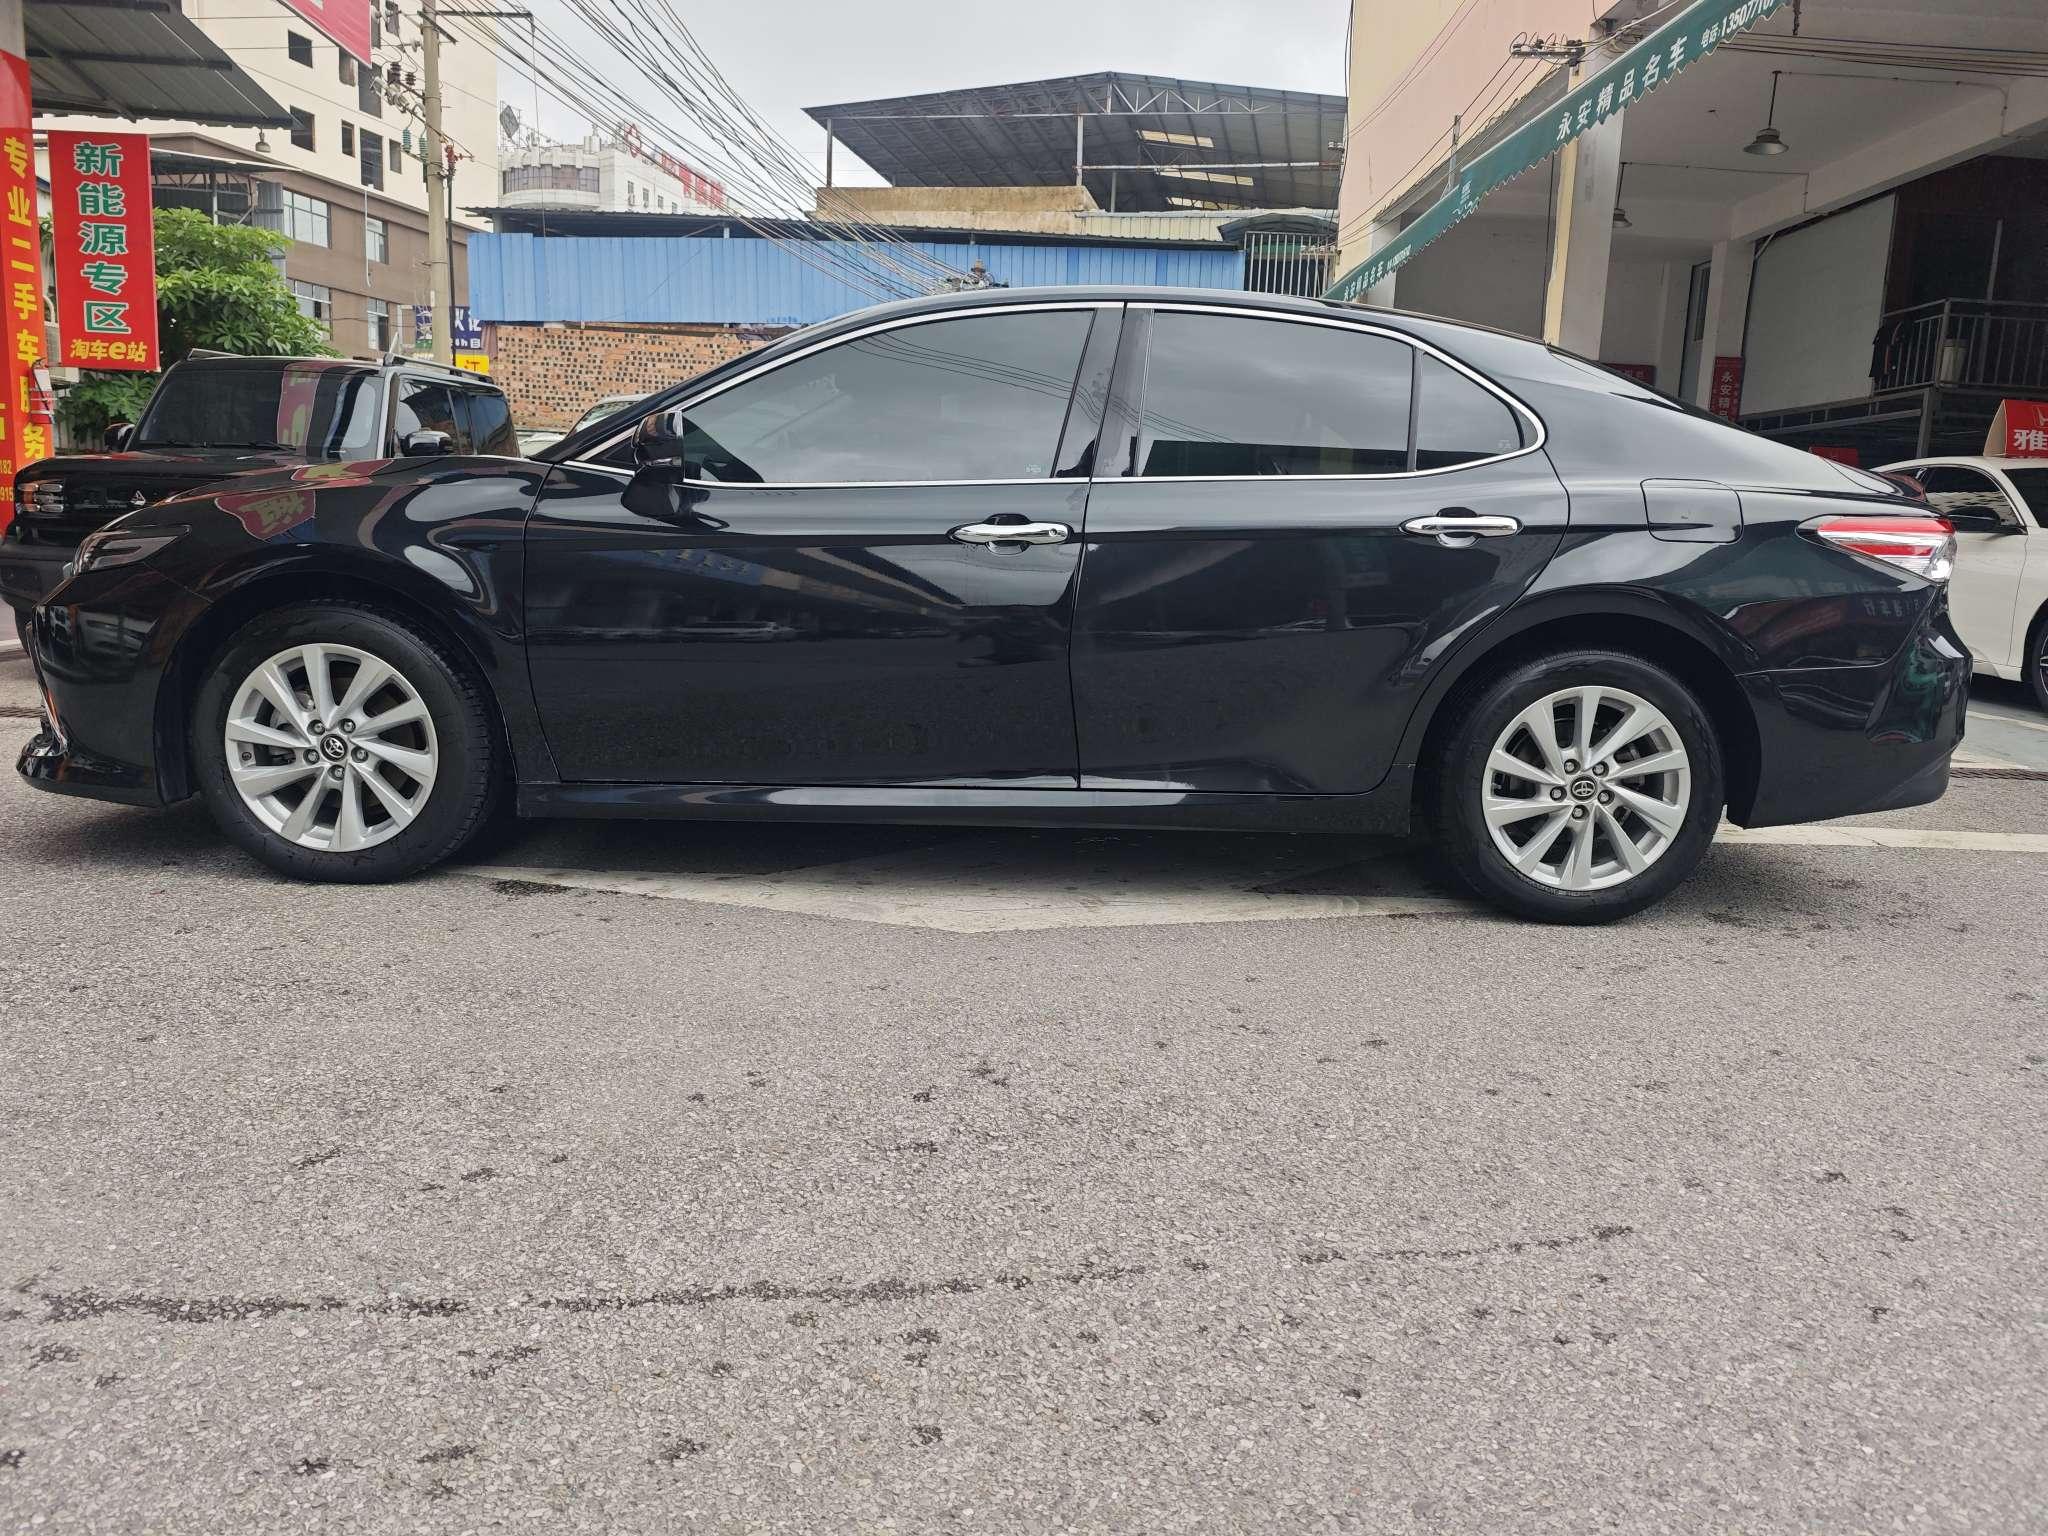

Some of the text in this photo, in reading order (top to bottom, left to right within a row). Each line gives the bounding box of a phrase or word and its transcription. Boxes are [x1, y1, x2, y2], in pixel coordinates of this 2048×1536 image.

[1556, 36, 1688, 141] 永安精品名车
[73, 141, 131, 335] 新能源专区
[69, 336, 147, 363] 淘车e站
